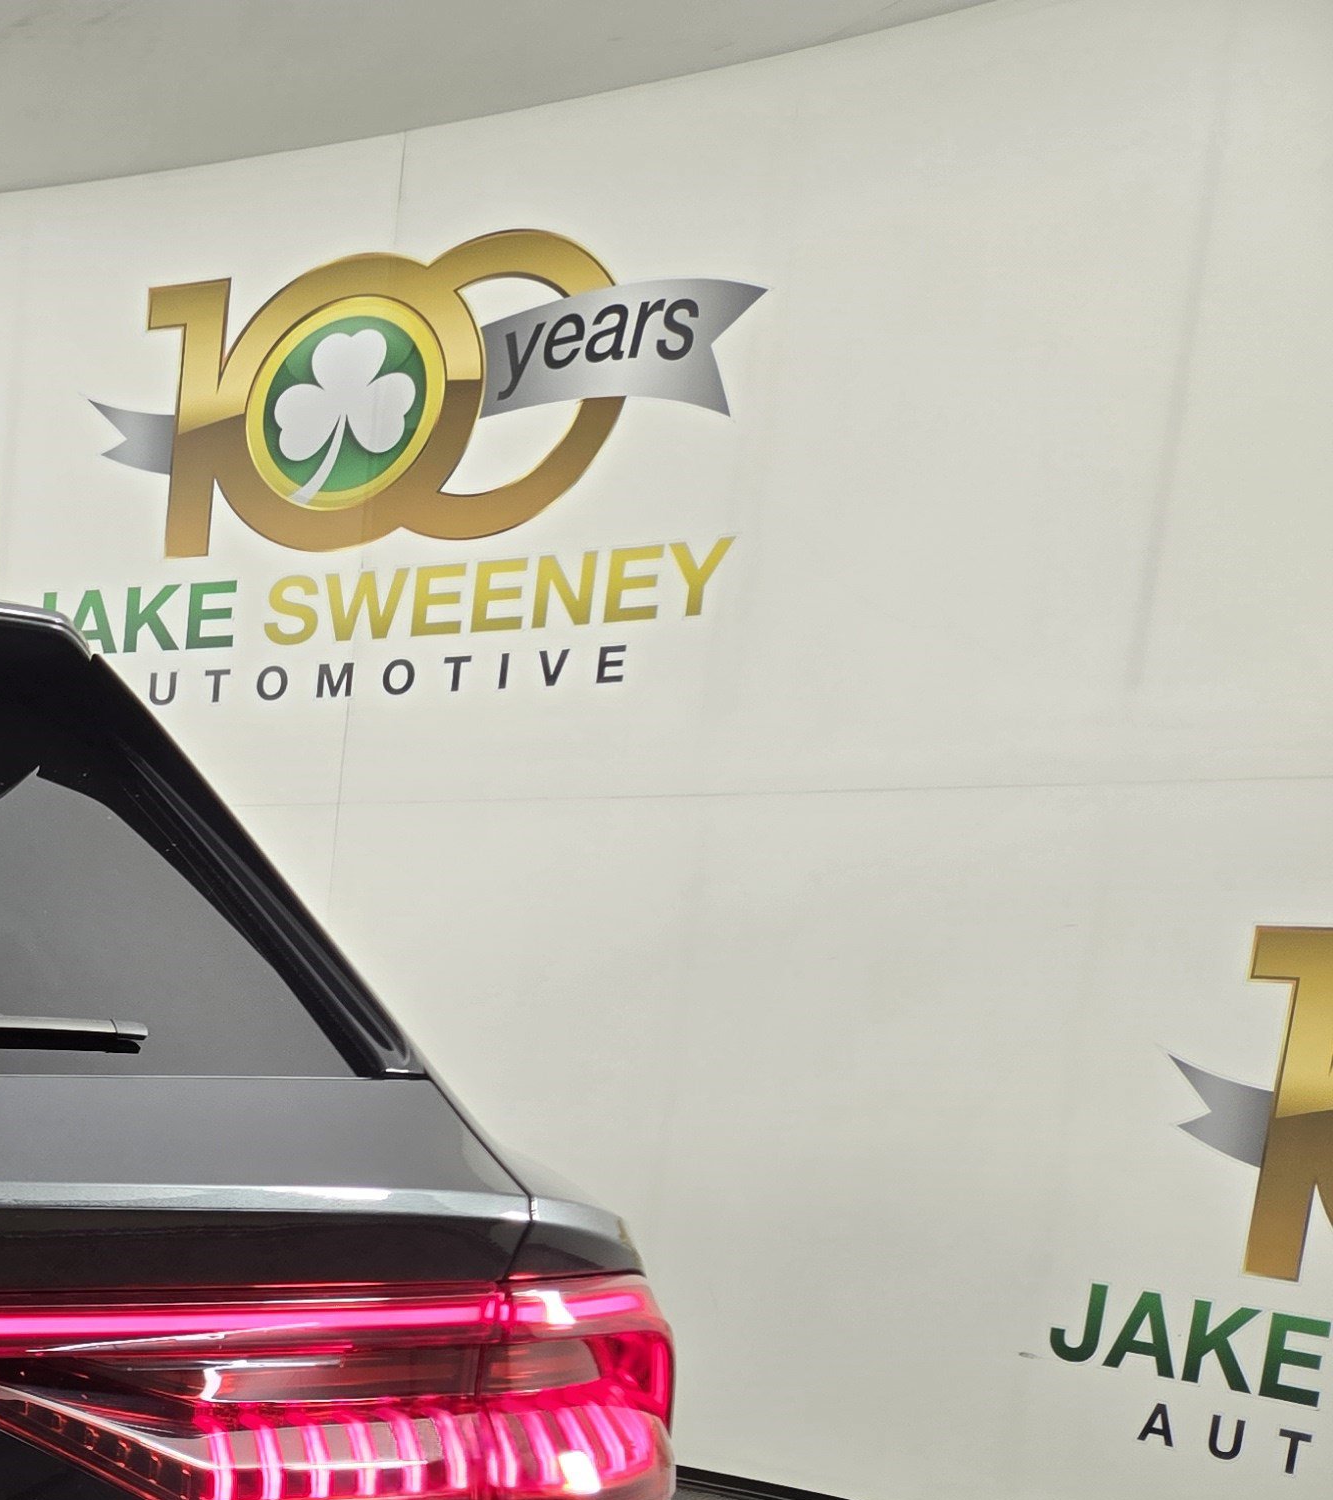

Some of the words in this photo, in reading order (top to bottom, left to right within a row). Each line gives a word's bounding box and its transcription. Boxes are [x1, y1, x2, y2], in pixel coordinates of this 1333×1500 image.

[497, 297, 699, 401] years
[264, 535, 736, 647] SWEENEY
[149, 644, 627, 706] UTOMOTIVE
[1050, 1283, 1332, 1407] JAKE
